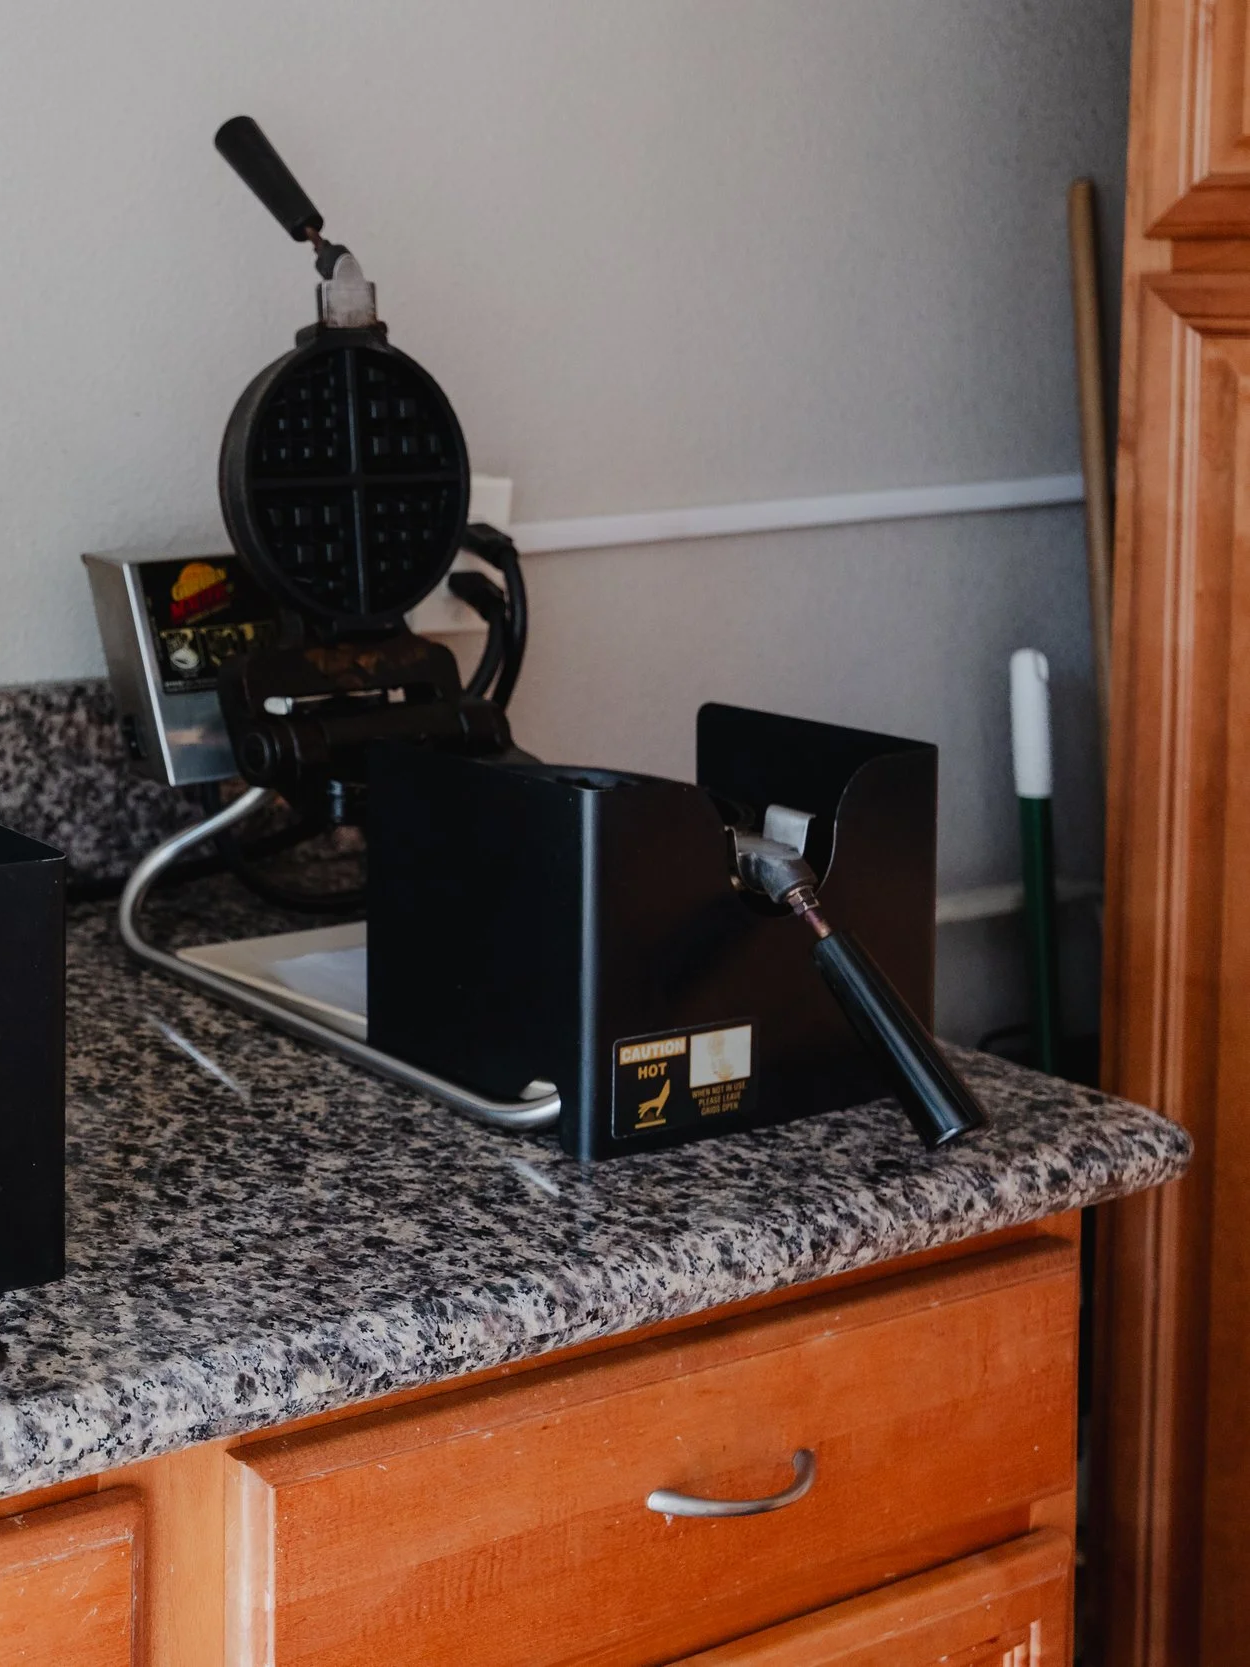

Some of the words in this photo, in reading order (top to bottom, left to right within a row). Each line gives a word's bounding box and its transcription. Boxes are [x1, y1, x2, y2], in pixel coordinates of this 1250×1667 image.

[621, 1038, 686, 1062] CAUTION
[638, 1062, 668, 1080] HOT
[692, 1088, 711, 1100] WHEN
[712, 1085, 724, 1094] NOT
[698, 1096, 721, 1108] PLEASE
[722, 1101, 738, 1112] OPEN
